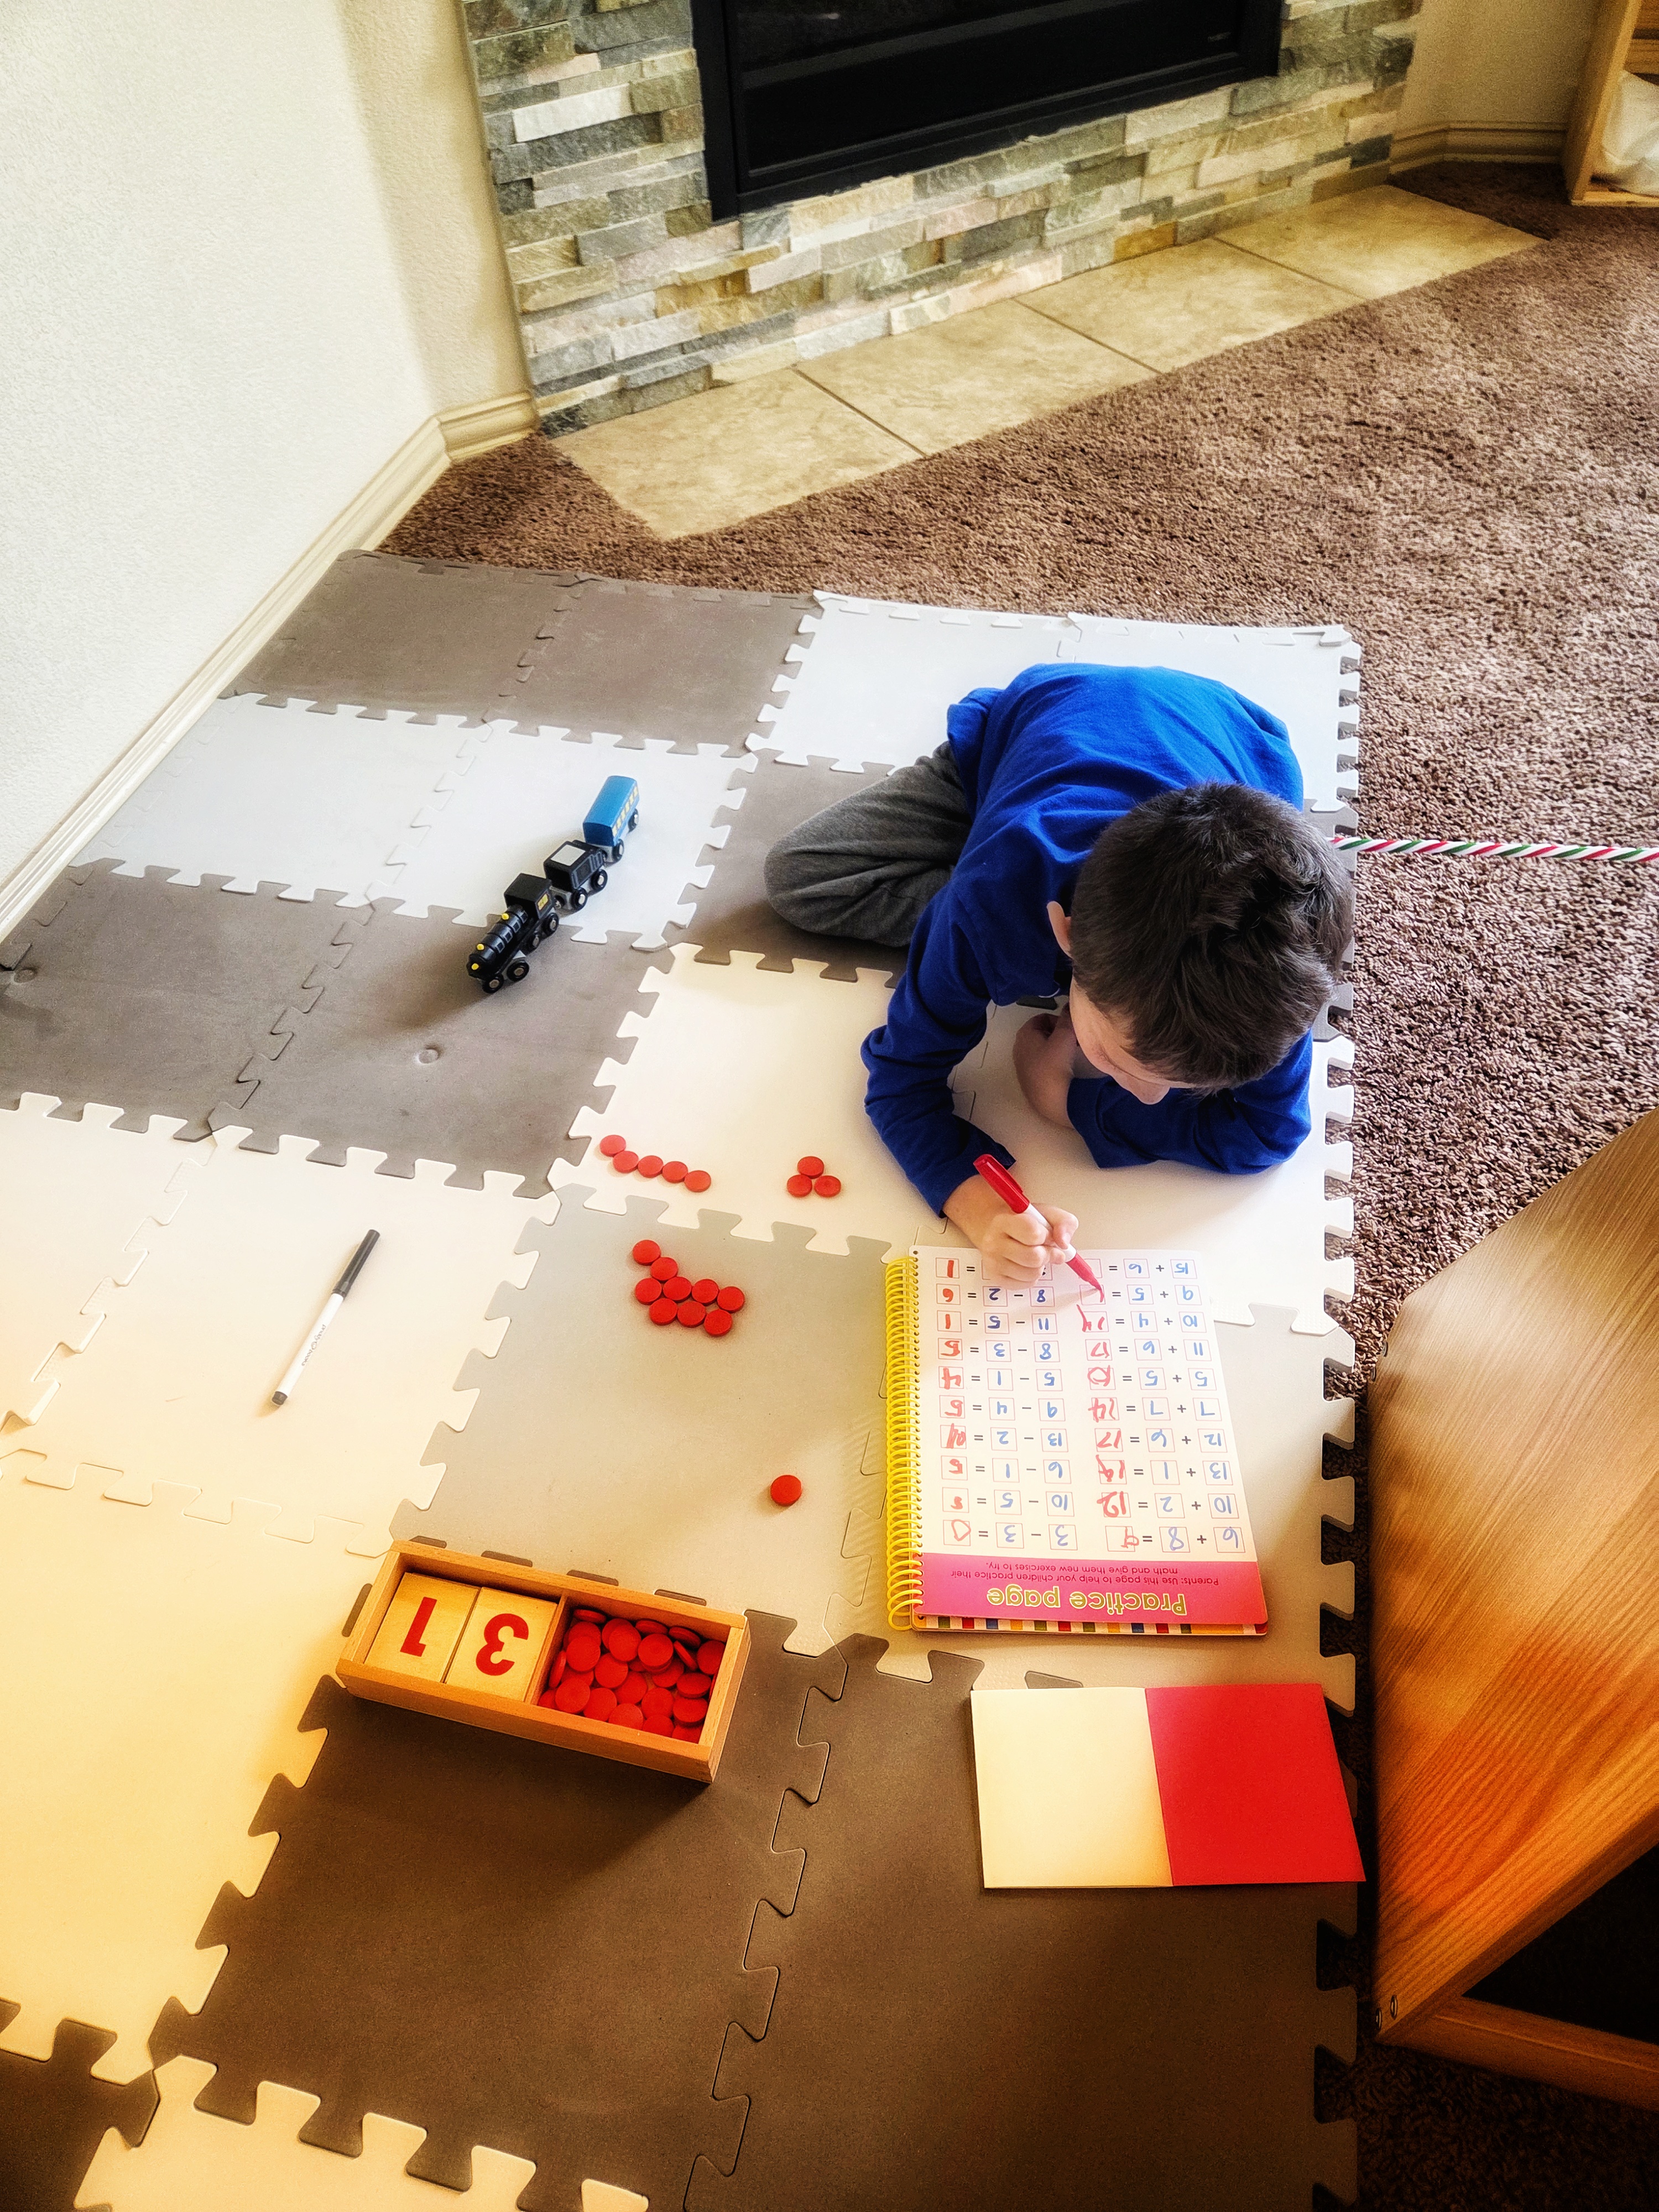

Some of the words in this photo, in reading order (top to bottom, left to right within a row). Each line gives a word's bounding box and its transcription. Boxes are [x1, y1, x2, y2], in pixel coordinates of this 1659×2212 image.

[1129, 1264, 1141, 1274] 6
[1175, 1263, 1188, 1274] 15
[943, 1288, 953, 1302] 6
[989, 1288, 1001, 1300] 2
[1037, 1290, 1045, 1302] 8
[1132, 1288, 1144, 1301] 5
[1183, 1286, 1193, 1300] 9
[946, 1314, 951, 1329] 1
[988, 1316, 1000, 1329] 5
[1038, 1318, 1048, 1330] 11
[1077, 1305, 1105, 1332] 14
[1139, 1313, 1149, 1328] 4
[1183, 1315, 1197, 1327] 10
[941, 1340, 960, 1356] 5
[994, 1343, 1005, 1357] 3
[1040, 1343, 1051, 1360] 8
[1091, 1342, 1109, 1358] 17
[1143, 1341, 1154, 1354] 6
[1194, 1343, 1203, 1355] 11
[301, 1349, 313, 1366] books
[942, 1368, 961, 1389] 4
[998, 1371, 1001, 1385] 1
[1044, 1373, 1055, 1386] 5
[1145, 1371, 1157, 1386] 5
[1195, 1371, 1207, 1386] 5
[945, 1400, 963, 1417] 5
[997, 1401, 1007, 1415] 4
[1047, 1402, 1057, 1418] 9
[1088, 1398, 1116, 1422] 14
[1151, 1401, 1164, 1415] 7
[1201, 1401, 1215, 1416] 7
[997, 1431, 1009, 1444] 2
[1047, 1433, 1062, 1447] 13
[1151, 1429, 1167, 1447] 6
[1204, 1433, 1221, 1446] 12
[949, 1459, 963, 1474] 5
[1006, 1464, 1010, 1478] 1
[1048, 1462, 1062, 1478] 6
[1164, 1462, 1168, 1479] 1
[1209, 1463, 1227, 1480] 13
[1000, 1493, 1013, 1507] 5
[1052, 1494, 1068, 1510] 10
[1097, 1491, 1126, 1517] 12
[1160, 1496, 1173, 1512] 2
[1214, 1495, 1232, 1514] 10
[952, 1520, 971, 1541] 0
[1004, 1525, 1016, 1542] 3
[1055, 1525, 1068, 1546] 3
[1223, 1527, 1238, 1548] 6
[1168, 1527, 1184, 1551] 8
[986, 1561, 1000, 1569] try.
[1014, 1563, 1056, 1572] exercises
[1108, 1564, 1129, 1573] give
[974, 1571, 1013, 1580] practice
[1015, 1573, 1053, 1583] children
[1056, 1573, 1076, 1582] your
[1079, 1574, 1101, 1584] help
[1115, 1574, 1140, 1583] page
[1181, 1577, 1218, 1585] Parents:
[986, 1583, 1060, 1609] page
[1069, 1590, 1186, 1616] Practice
[400, 1597, 437, 1657] 1
[476, 1614, 529, 1676] 3
